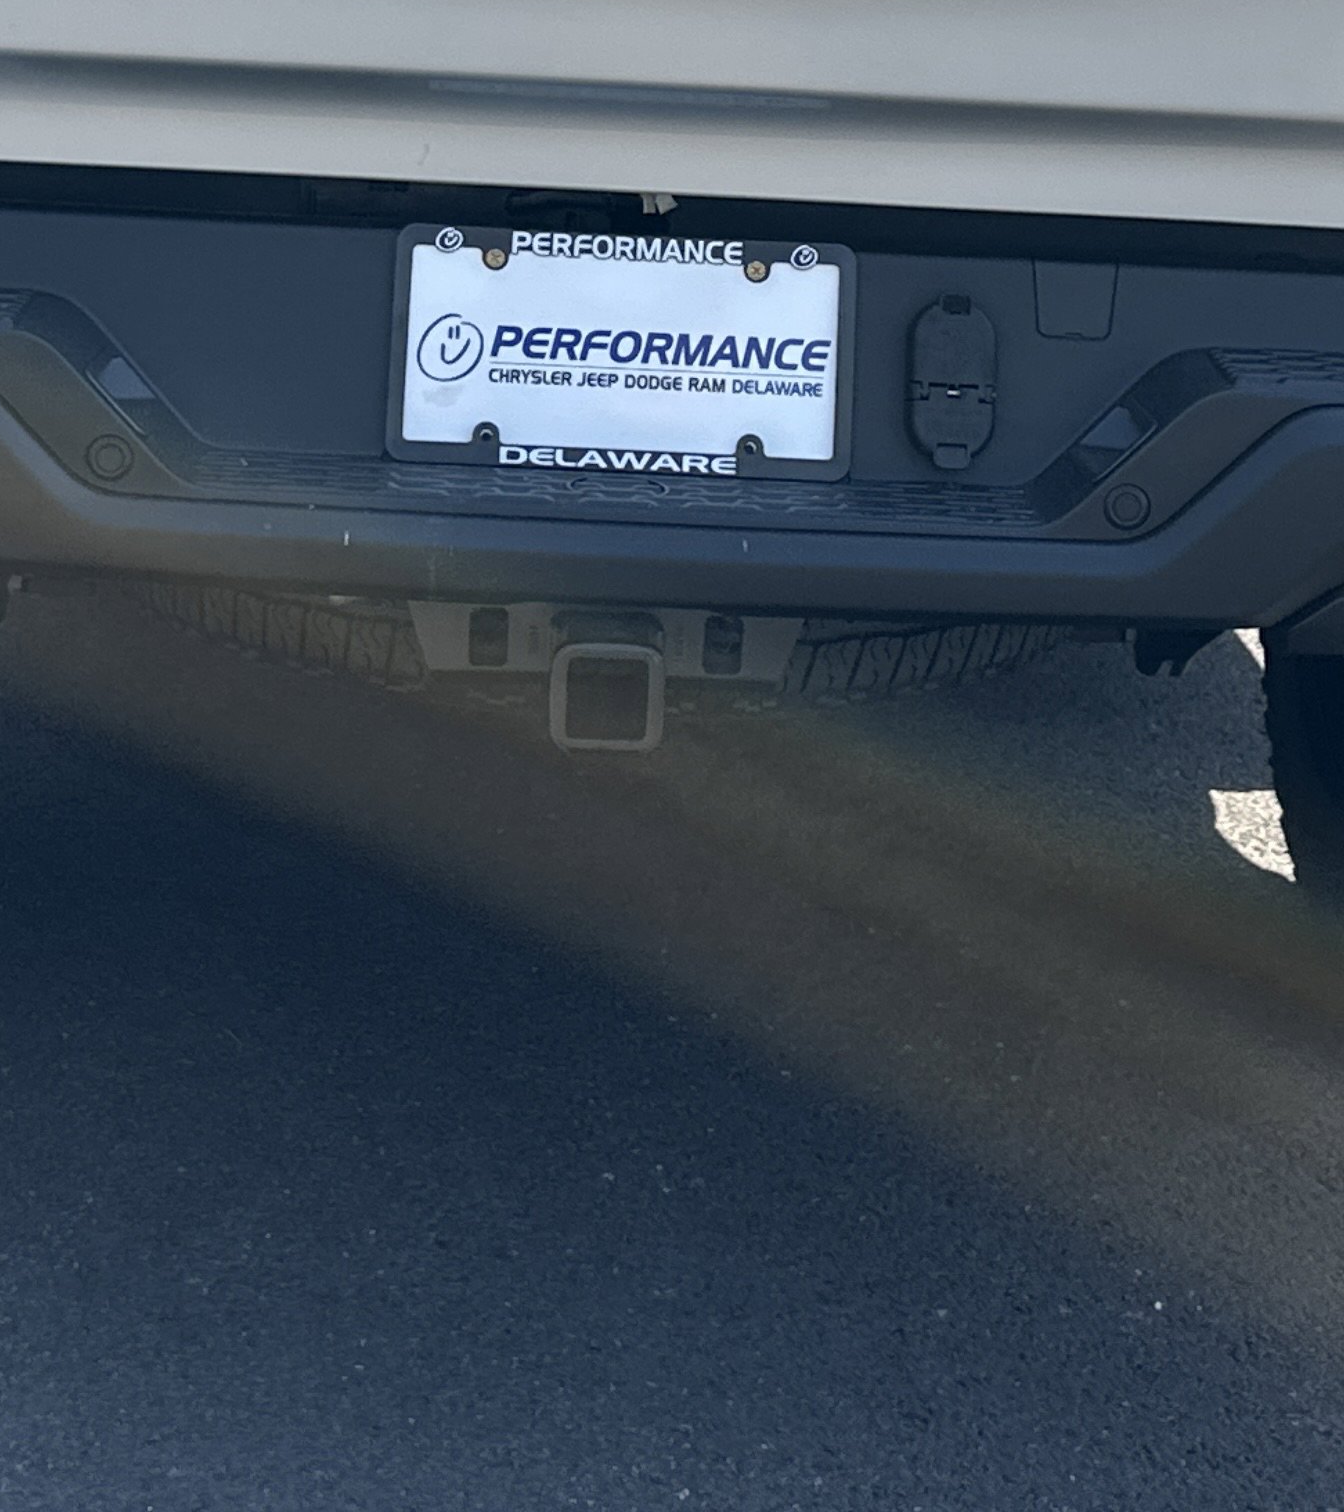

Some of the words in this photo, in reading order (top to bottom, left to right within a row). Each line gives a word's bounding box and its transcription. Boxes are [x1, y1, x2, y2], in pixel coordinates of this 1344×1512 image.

[511, 230, 744, 266] PERFORMANCE
[490, 325, 832, 371] PERFORMANCE
[488, 369, 572, 387] CHRYSLER
[577, 373, 619, 389] JEEP
[624, 374, 683, 393] DODGE
[688, 377, 726, 394] RAM
[731, 379, 823, 399] DELAWARE
[499, 445, 737, 476] DELAWARE
